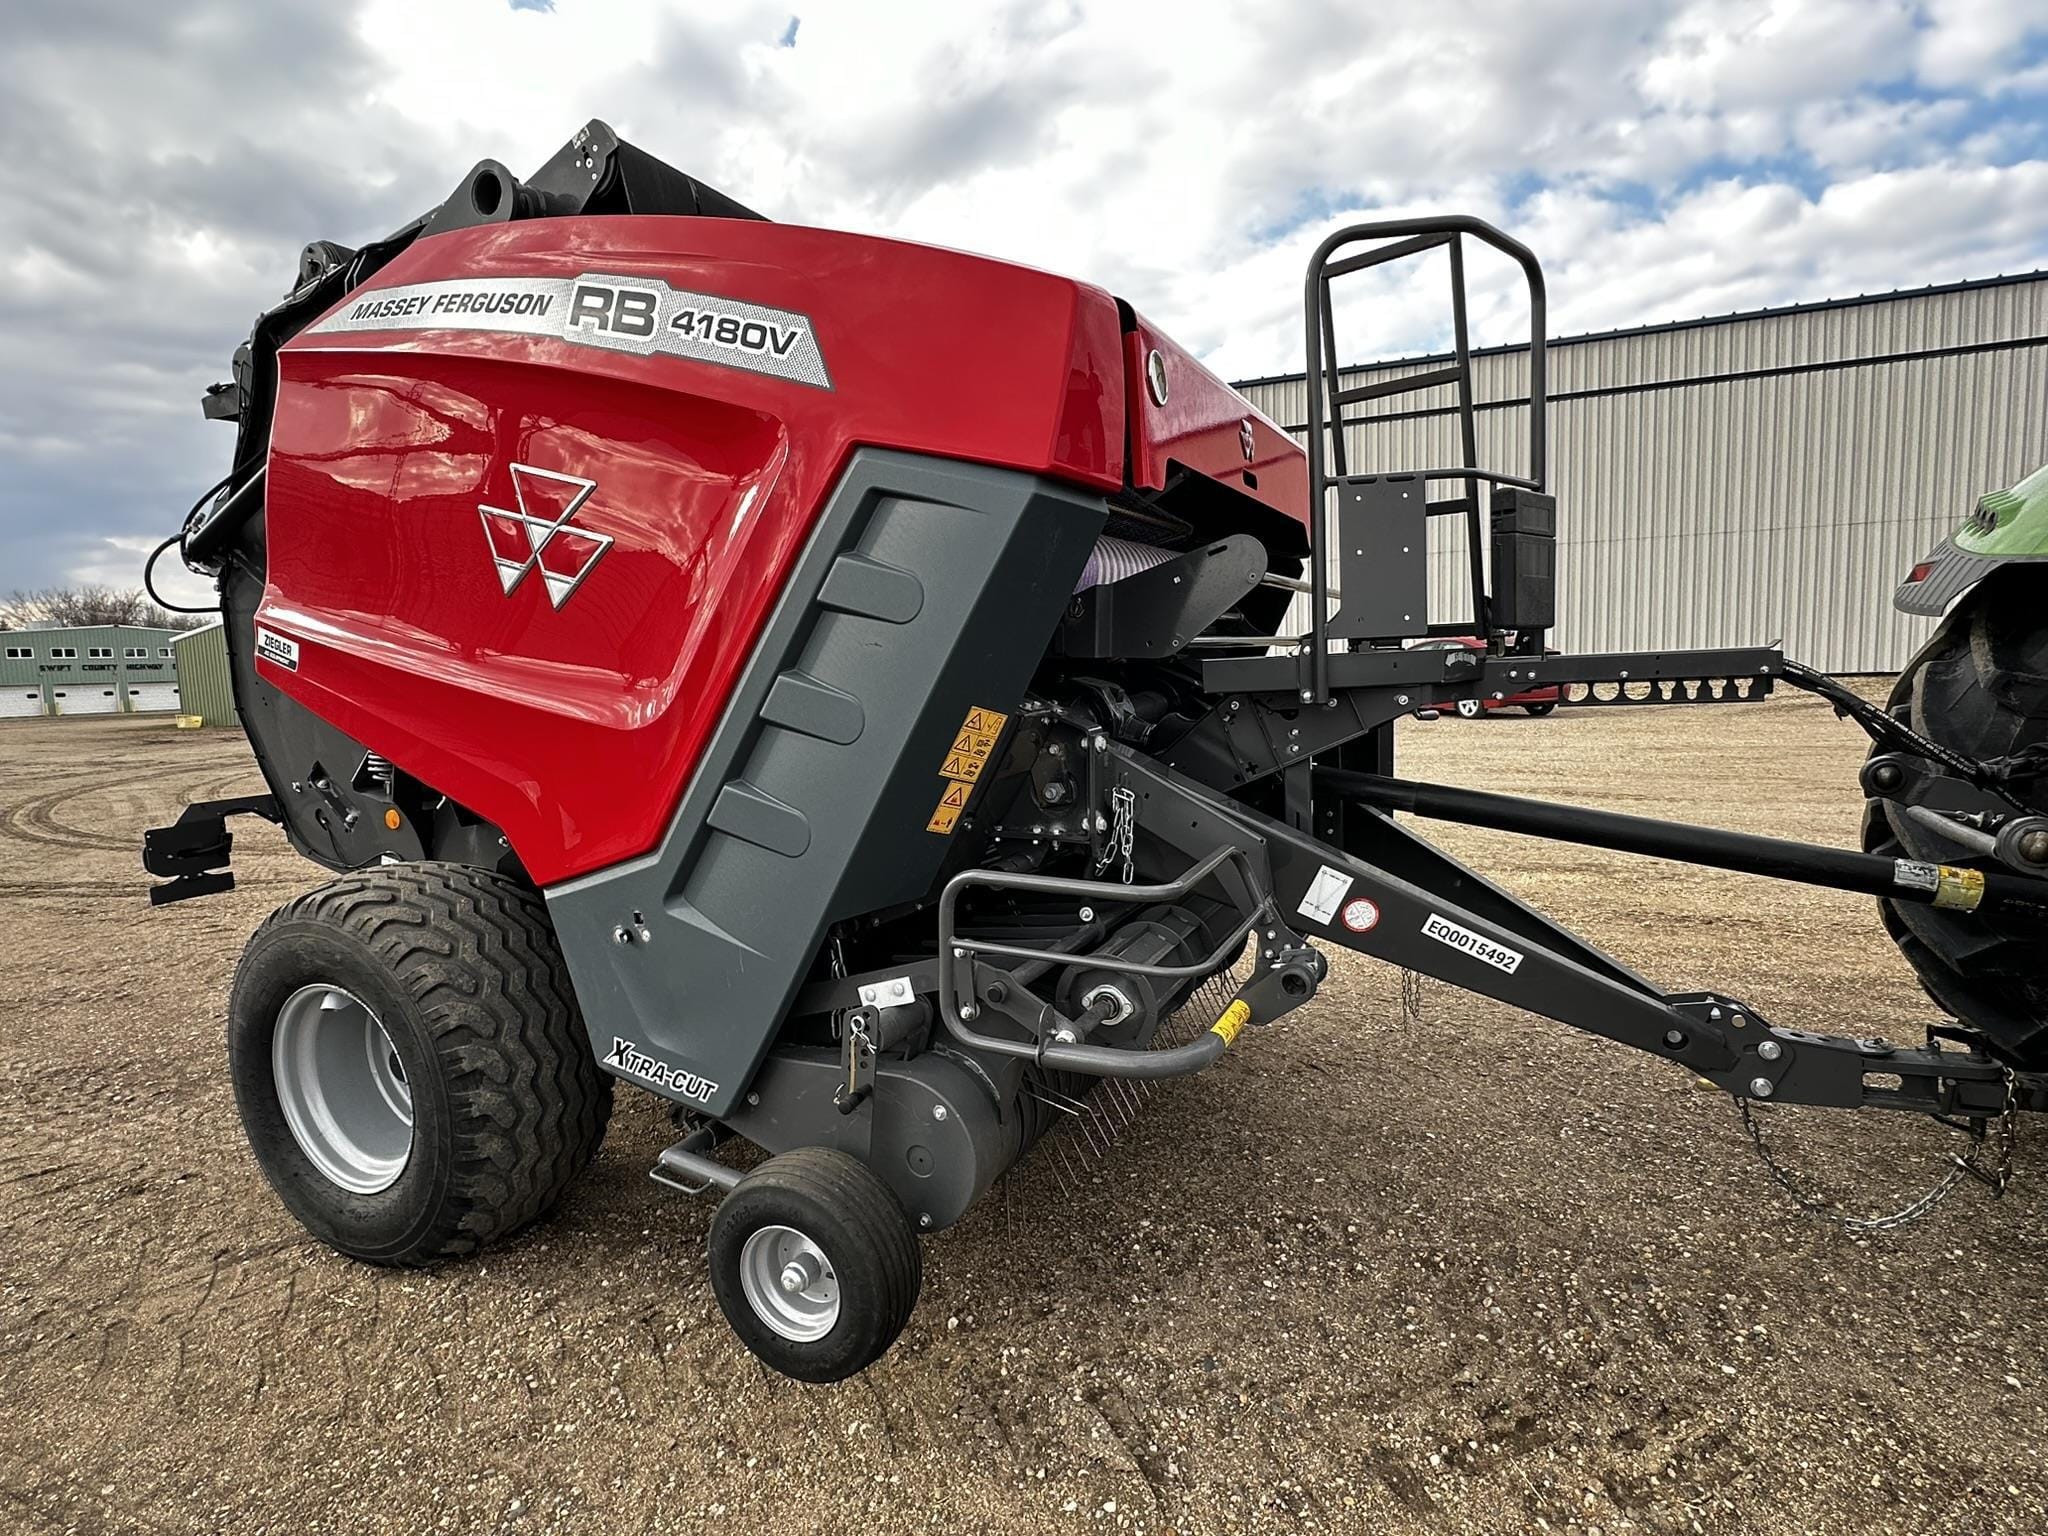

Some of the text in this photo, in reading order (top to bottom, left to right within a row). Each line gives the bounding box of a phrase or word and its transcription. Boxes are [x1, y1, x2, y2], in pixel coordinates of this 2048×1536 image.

[350, 293, 553, 321] MASSEY FERGUSON
[569, 285, 798, 355] RB 4180V
[264, 634, 292, 657] ZIEGLER
[126, 663, 164, 671] HIGHWAY
[1427, 920, 1516, 970] EQ0015492
[605, 1038, 717, 1102] XTRA-CUT
